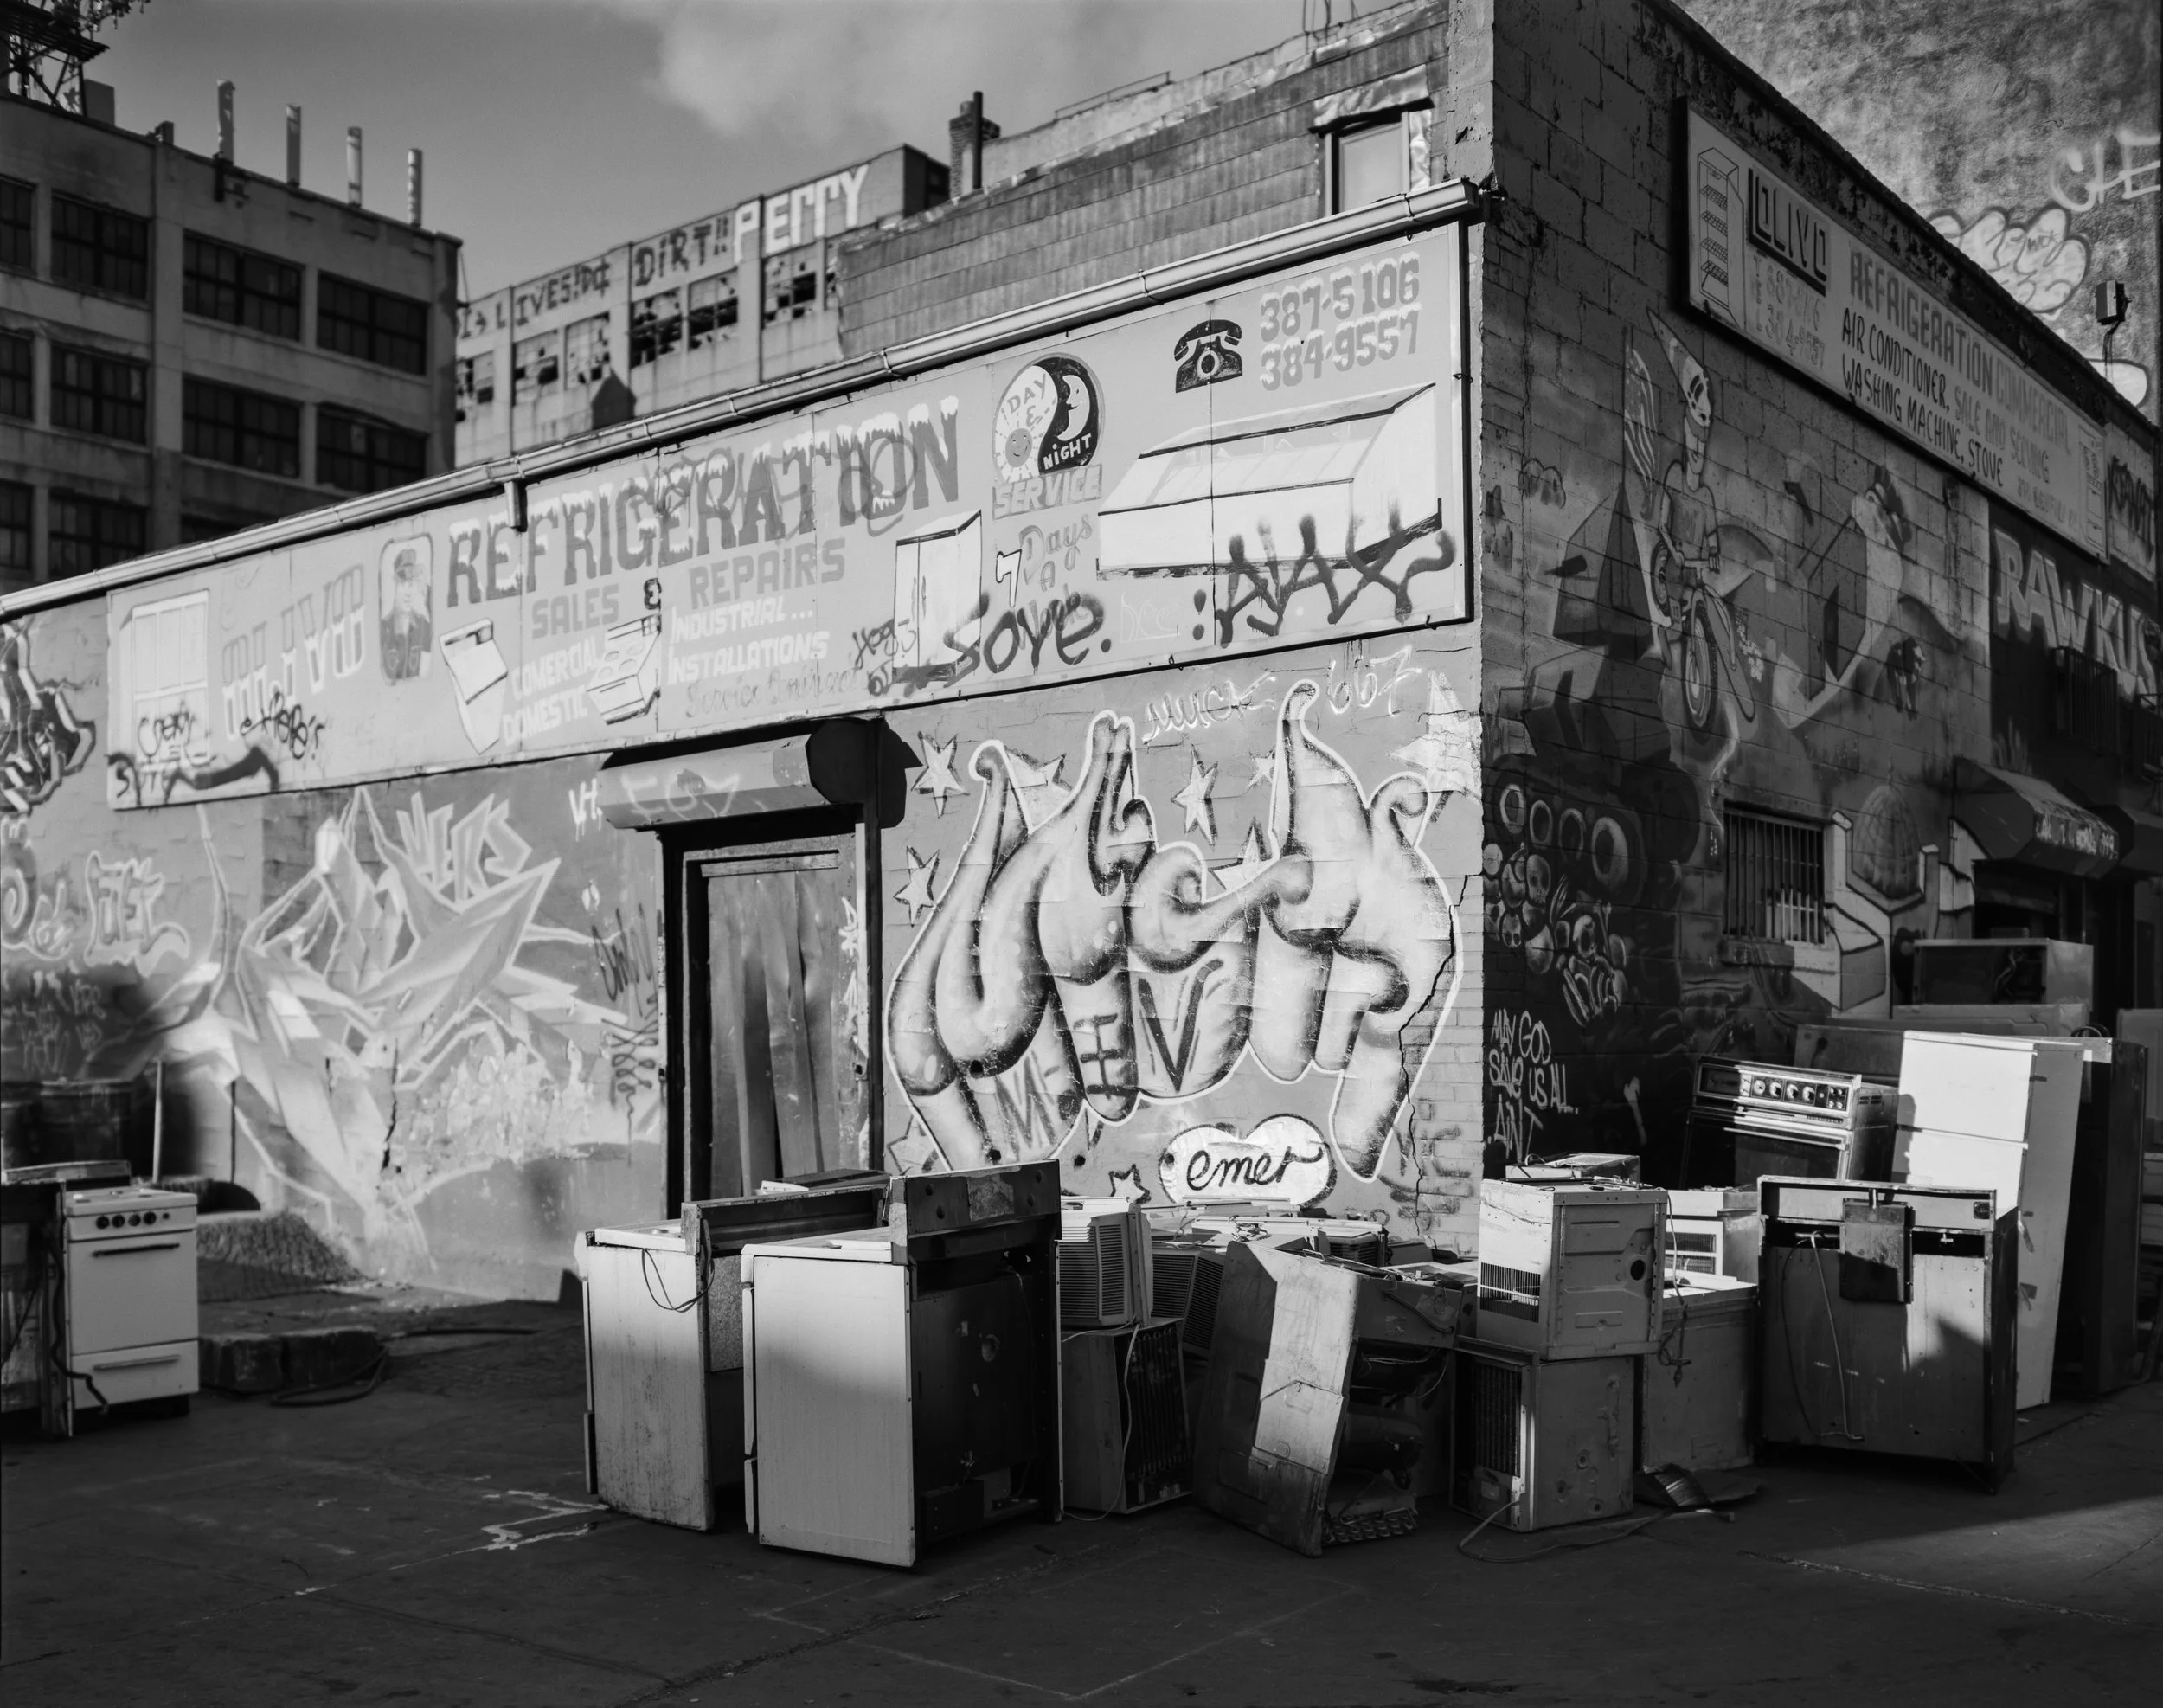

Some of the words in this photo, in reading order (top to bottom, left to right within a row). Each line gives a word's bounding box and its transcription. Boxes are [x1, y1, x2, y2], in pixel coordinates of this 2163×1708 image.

[1260, 250, 1420, 343] 387-5106
[1842, 307, 1865, 355] AIR
[1850, 250, 1994, 397] REFRIGERATION
[1259, 303, 1422, 391] 384-9557
[1007, 373, 1047, 414] DAY
[1842, 352, 1903, 424] WASHING
[1907, 395, 1965, 465] MACHINE,
[1967, 438, 2004, 489] STOVE
[447, 395, 959, 607] REFRIGERATION
[994, 466, 1102, 514] SERVICE
[531, 583, 619, 639] SALES
[689, 536, 846, 609] REPAIRS
[995, 549, 1022, 607] 7
[1491, 1007, 1517, 1056] MAY
[1518, 1010, 1552, 1065] GOD
[1529, 1066, 1548, 1109] US
